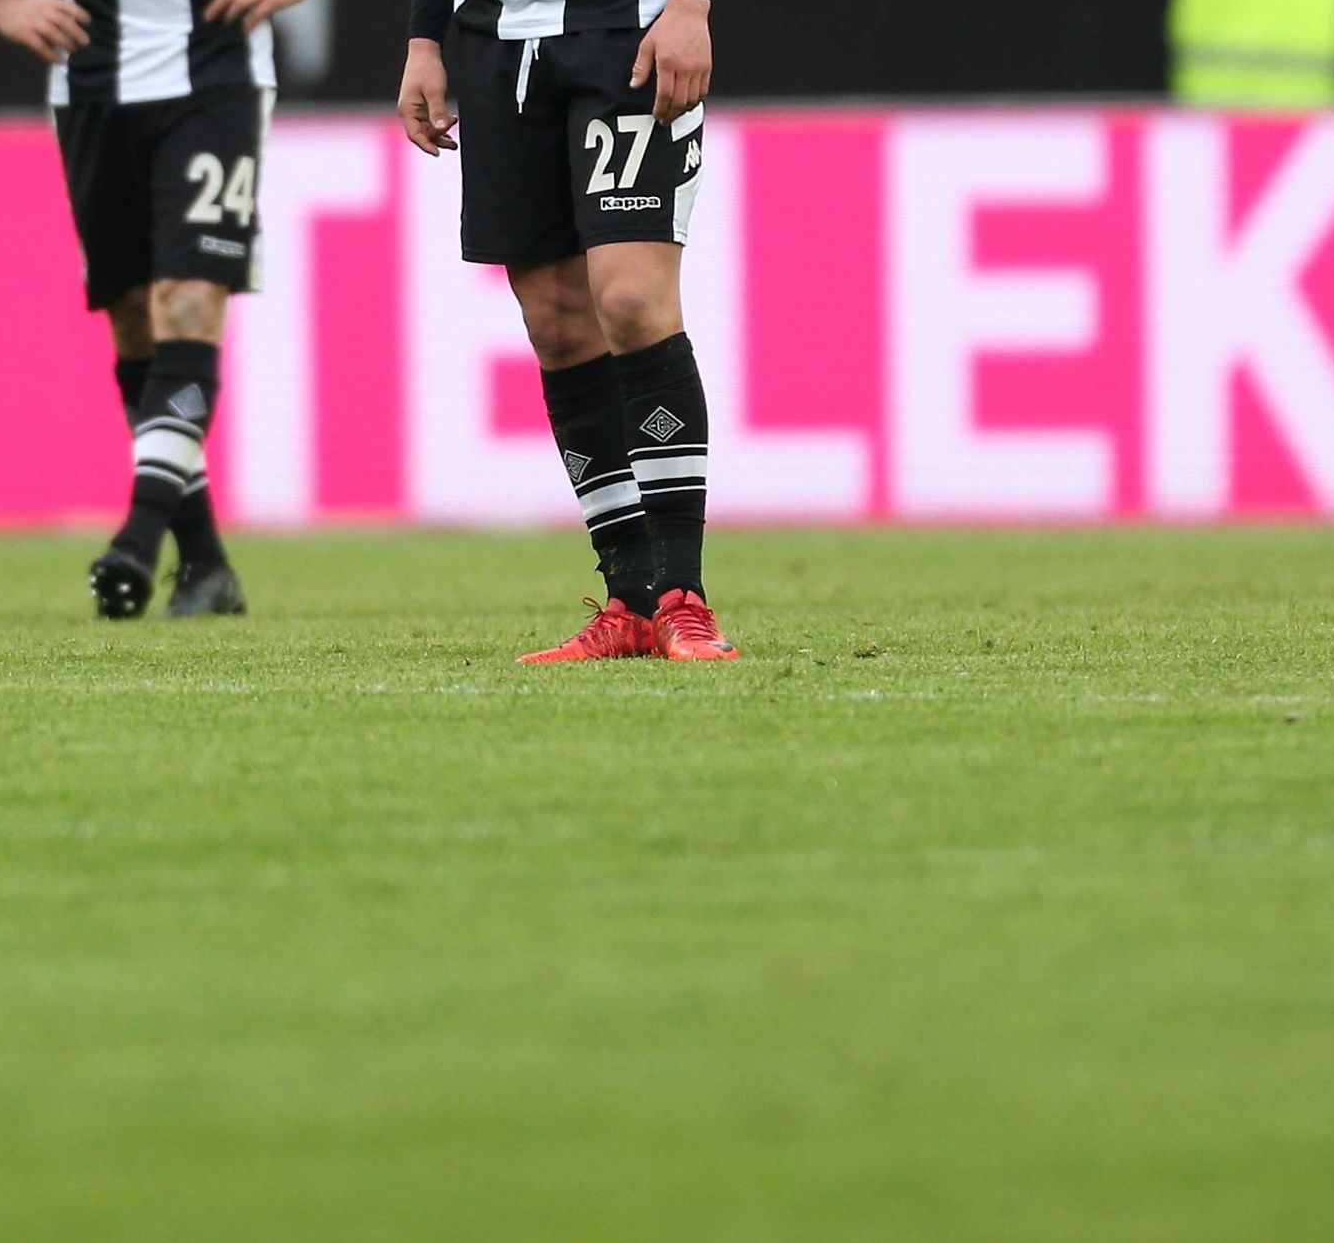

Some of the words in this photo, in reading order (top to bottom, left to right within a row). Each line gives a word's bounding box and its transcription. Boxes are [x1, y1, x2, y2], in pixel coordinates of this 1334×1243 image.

[186, 152, 255, 227] 24
[584, 114, 656, 195] 27
[601, 196, 660, 211] Kappa
